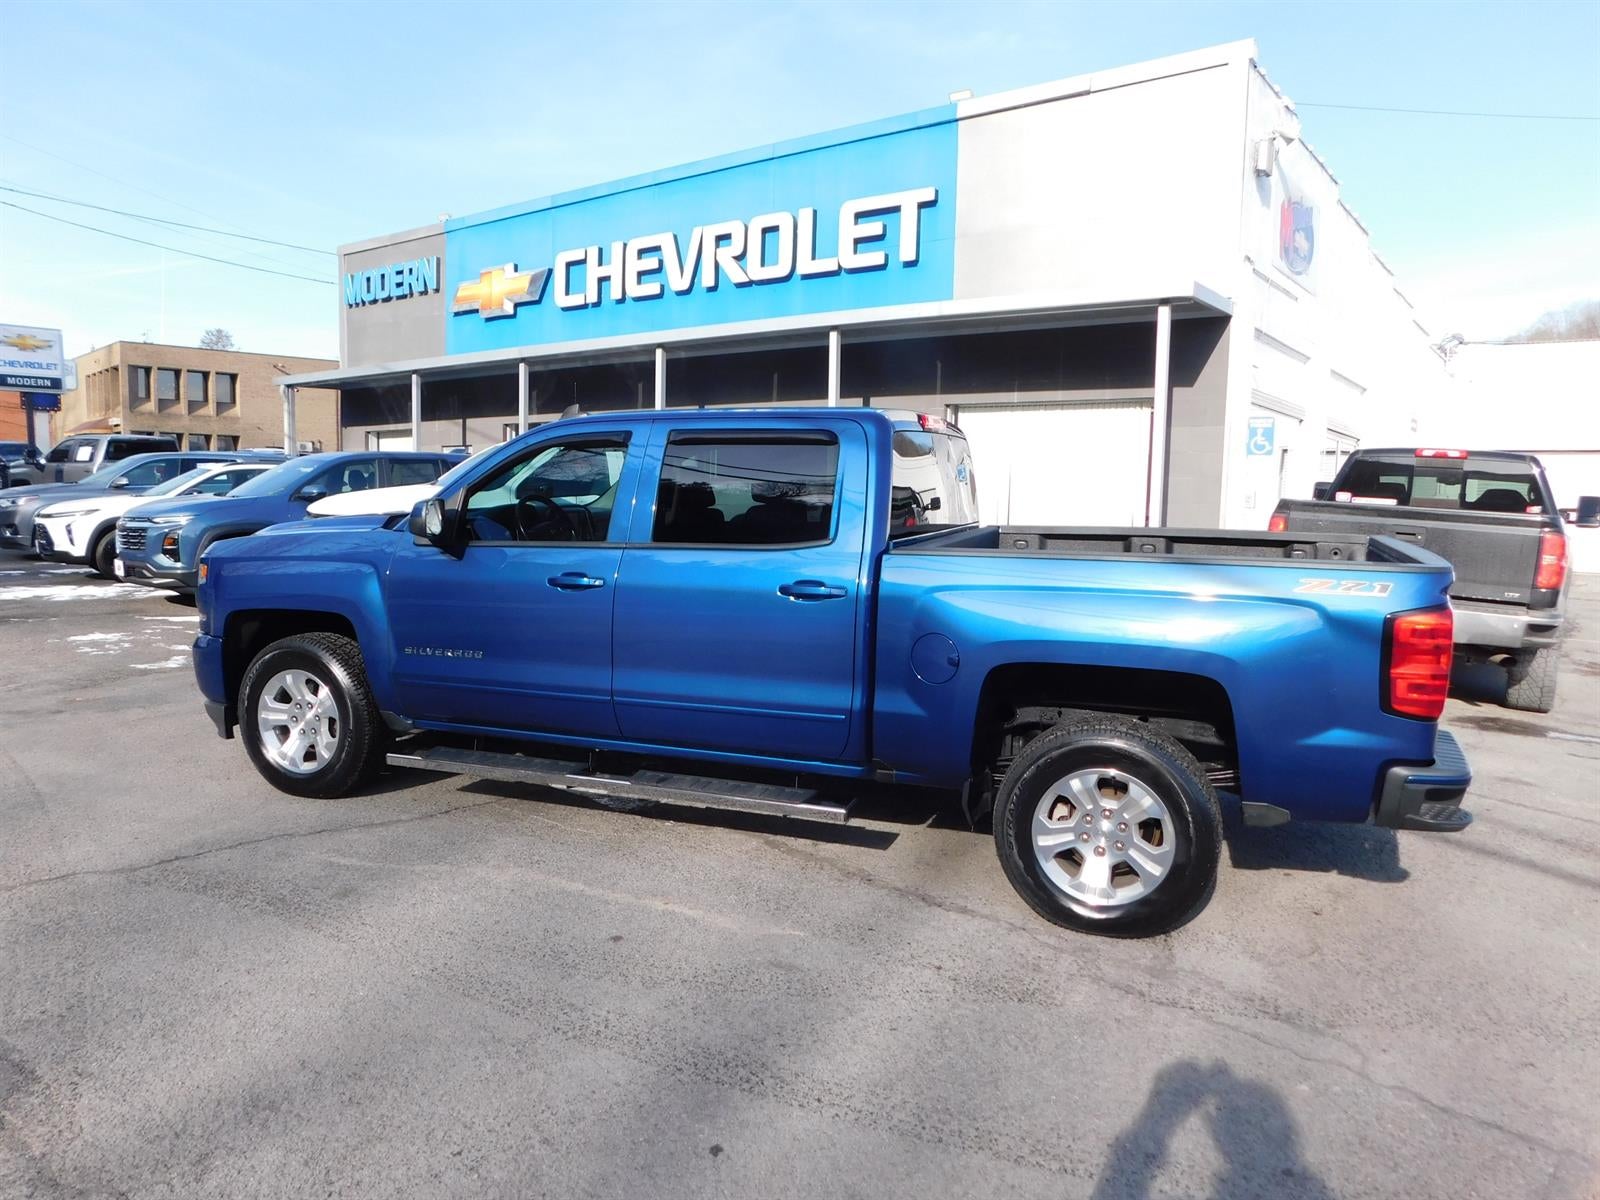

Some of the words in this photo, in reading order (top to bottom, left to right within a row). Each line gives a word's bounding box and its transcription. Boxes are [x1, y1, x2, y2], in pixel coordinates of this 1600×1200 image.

[554, 186, 938, 311] CHEVROLET
[343, 255, 440, 308] MODERN
[7, 376, 51, 387] MODERN
